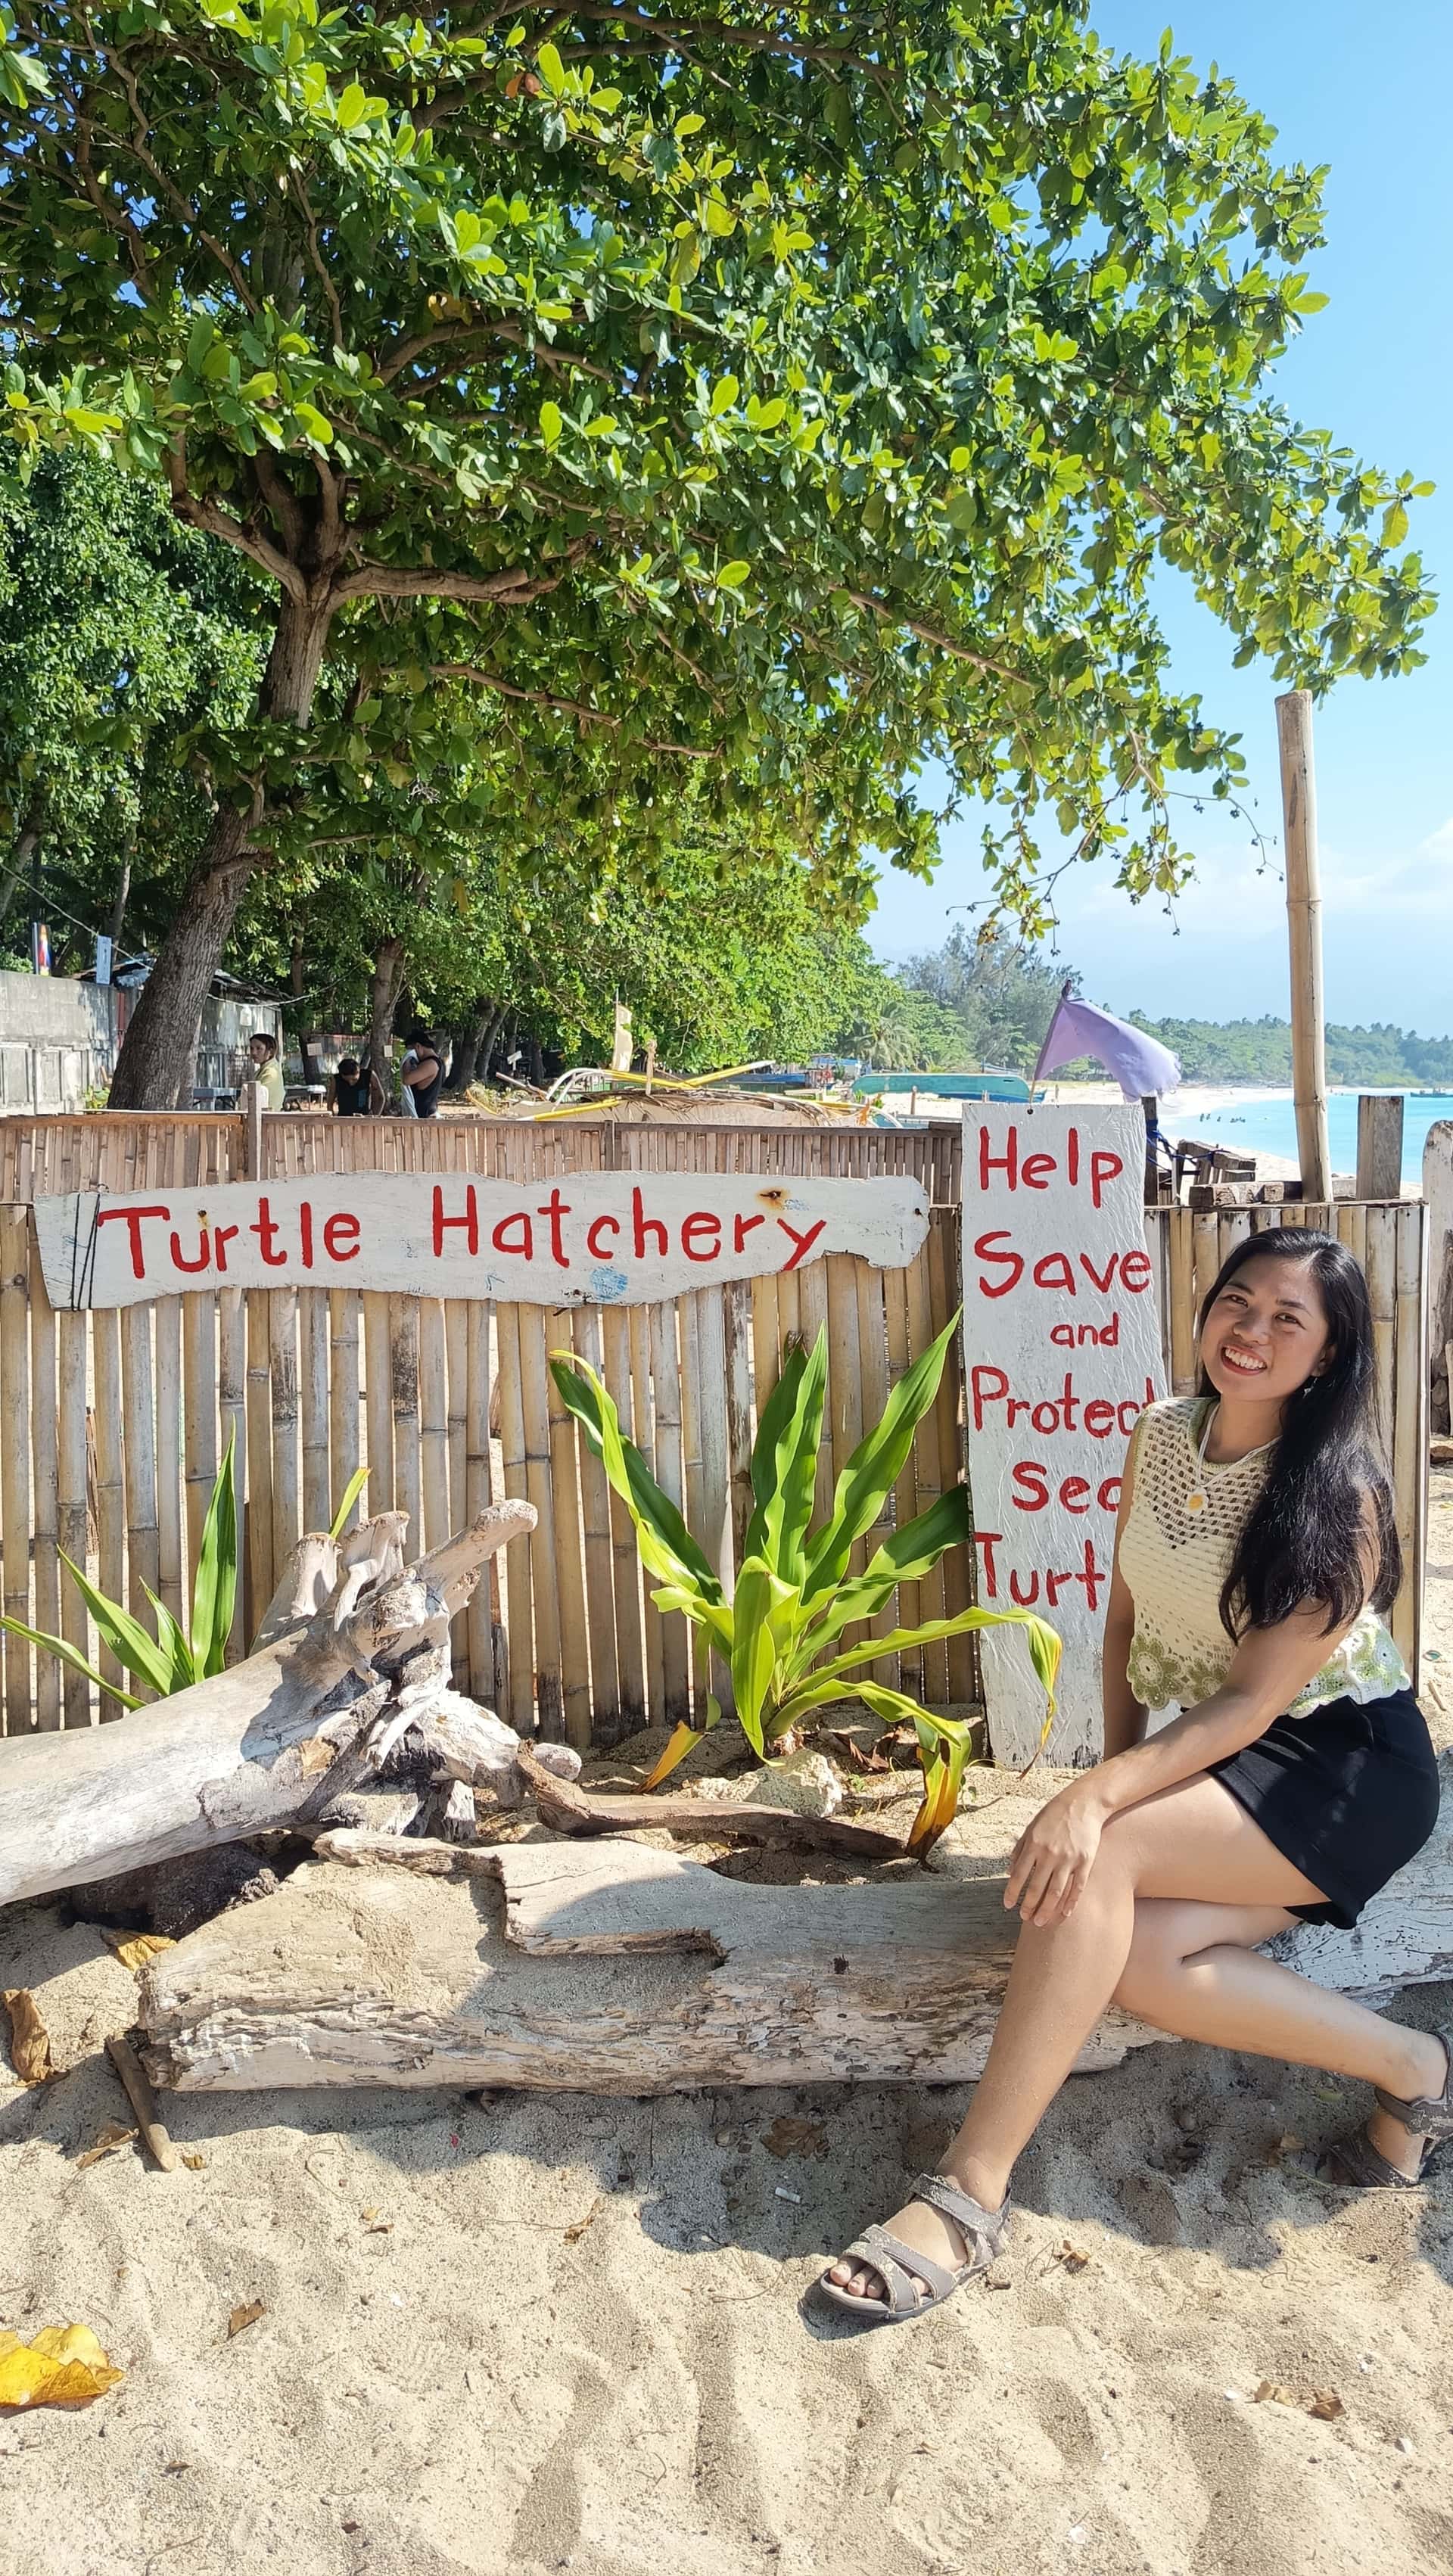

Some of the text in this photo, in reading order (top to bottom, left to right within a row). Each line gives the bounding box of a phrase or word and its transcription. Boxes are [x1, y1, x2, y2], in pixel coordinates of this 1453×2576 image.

[979, 1126, 1123, 1209] Help
[97, 1185, 827, 1279] Turtle Hatchery
[974, 1231, 1151, 1299] Save
[1050, 1312, 1119, 1349] and
